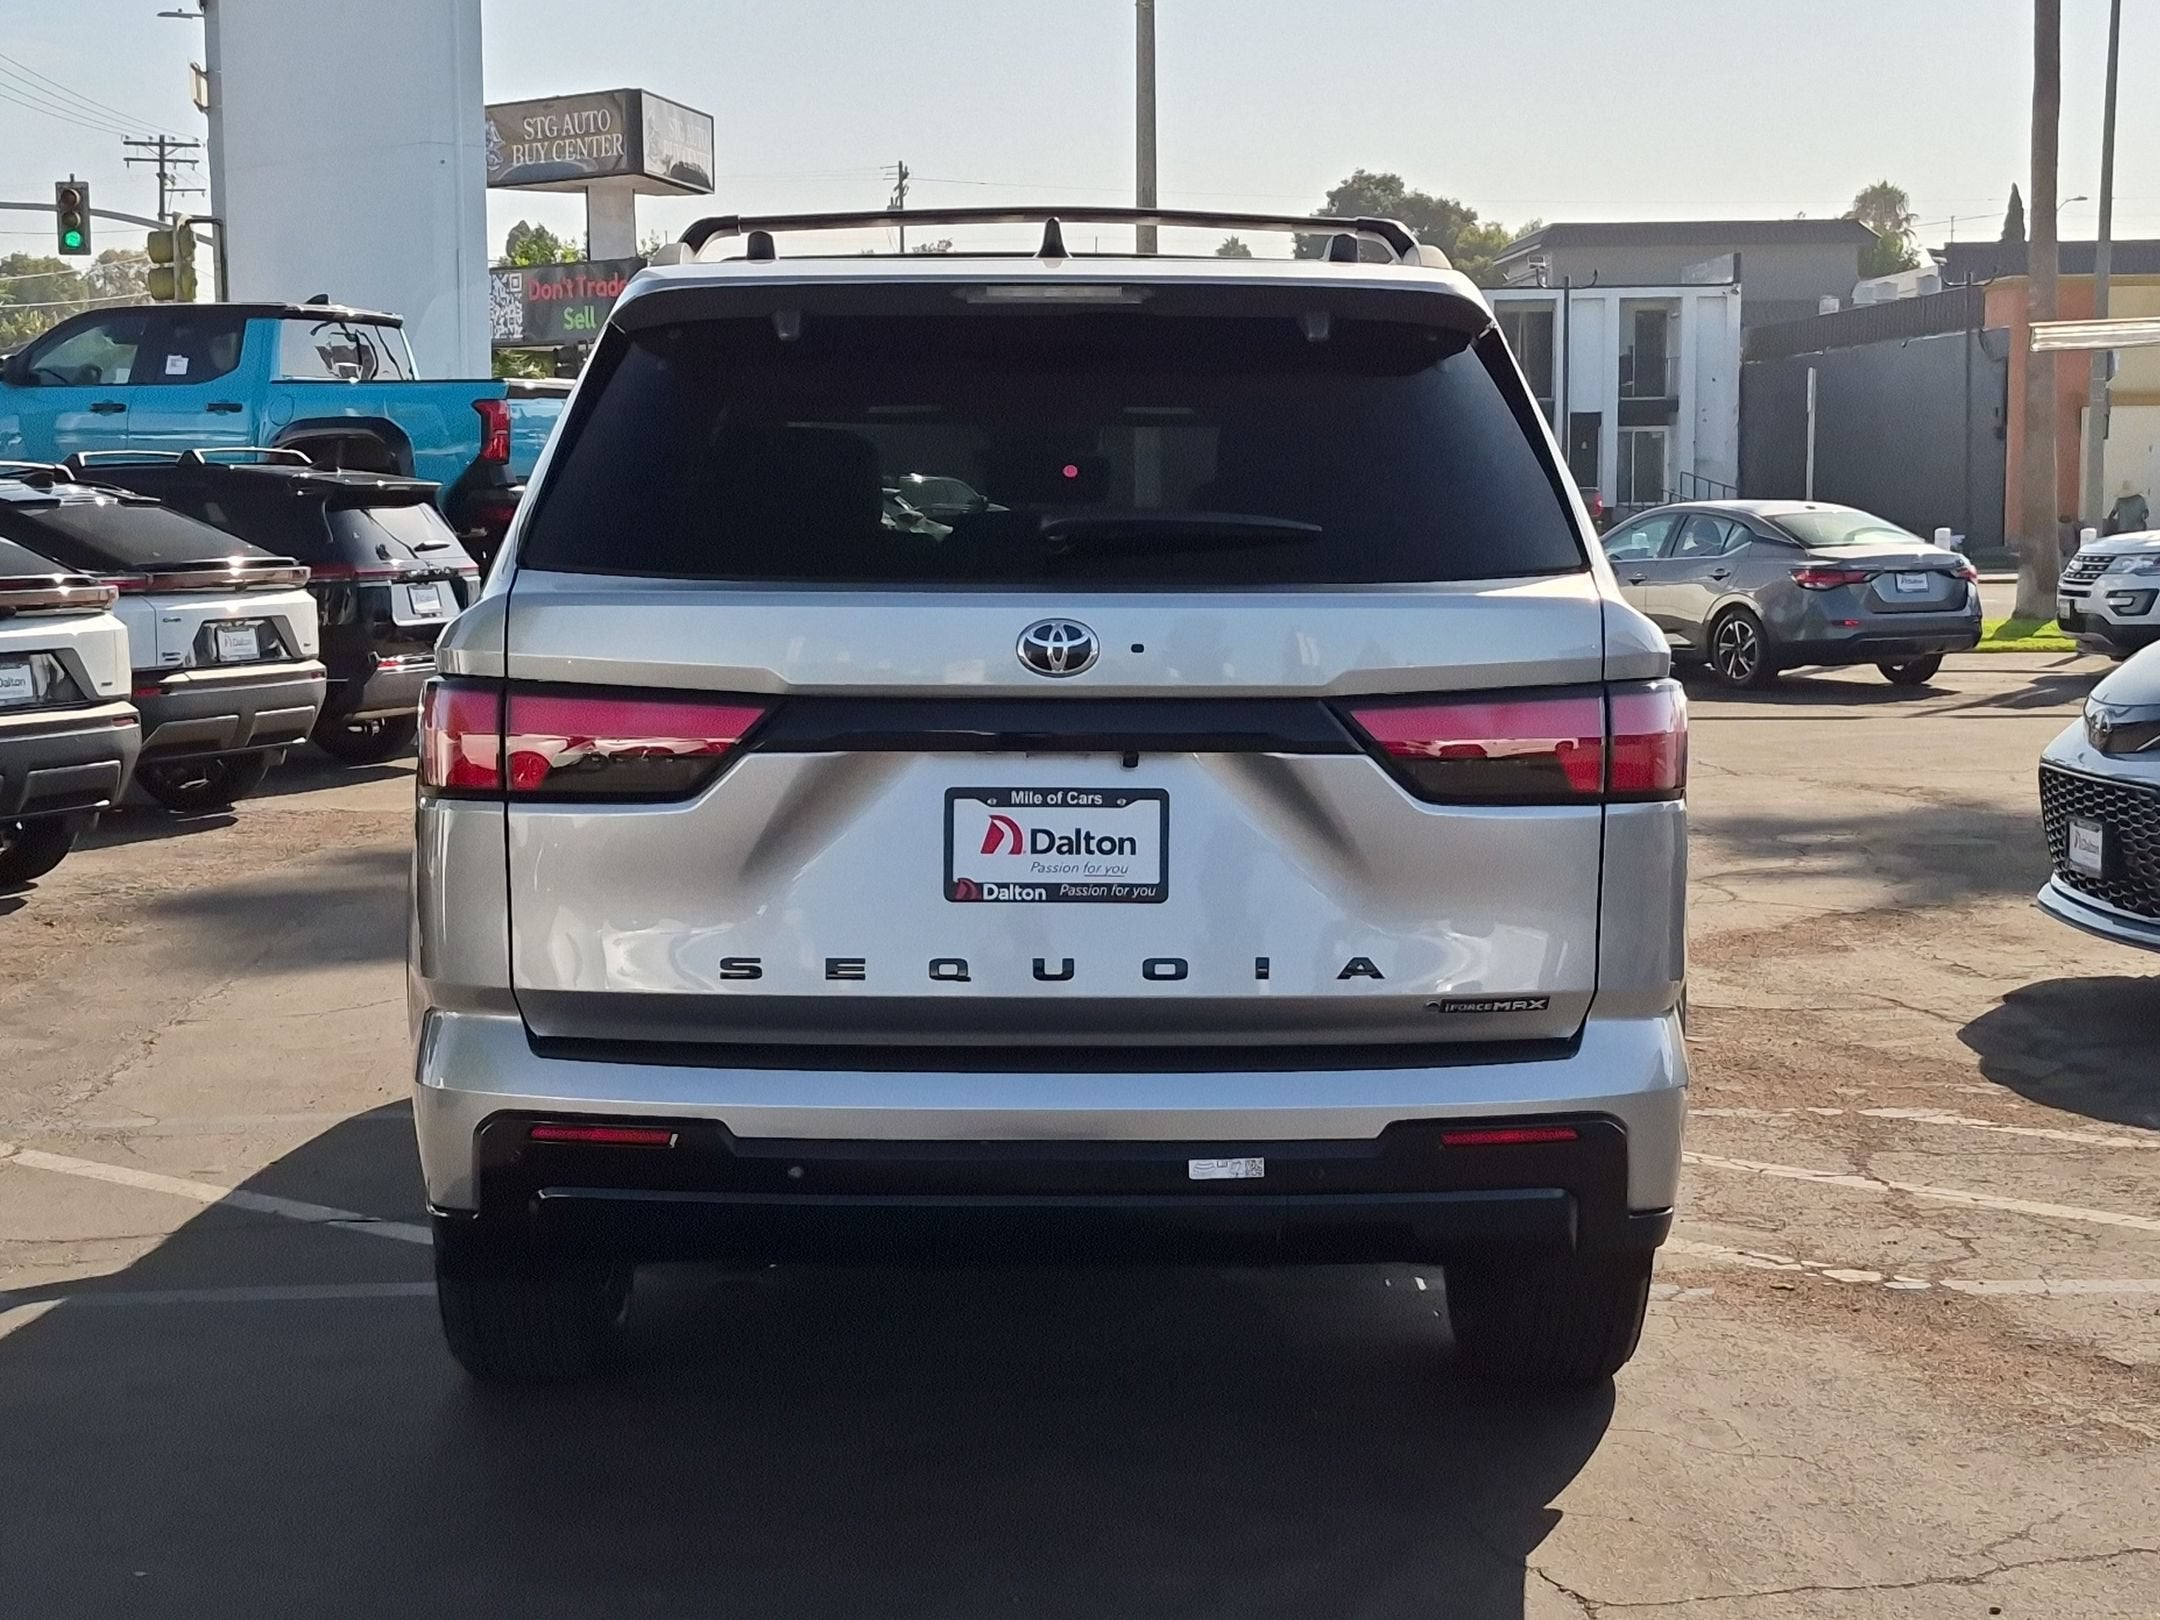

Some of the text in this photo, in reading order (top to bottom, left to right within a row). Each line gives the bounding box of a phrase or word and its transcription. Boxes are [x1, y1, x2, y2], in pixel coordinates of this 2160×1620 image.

[523, 108, 611, 140] STG AUTO
[512, 133, 625, 167] BUY CENTER
[528, 276, 574, 301] Don't
[563, 305, 597, 330] Sell
[1011, 791, 1103, 805] Mile of Cars
[1030, 828, 1136, 856] Dalton
[1030, 861, 1128, 876] Passion for you
[982, 884, 1157, 901] Dalton Passion for you
[719, 956, 1386, 982] SEQUOIA
